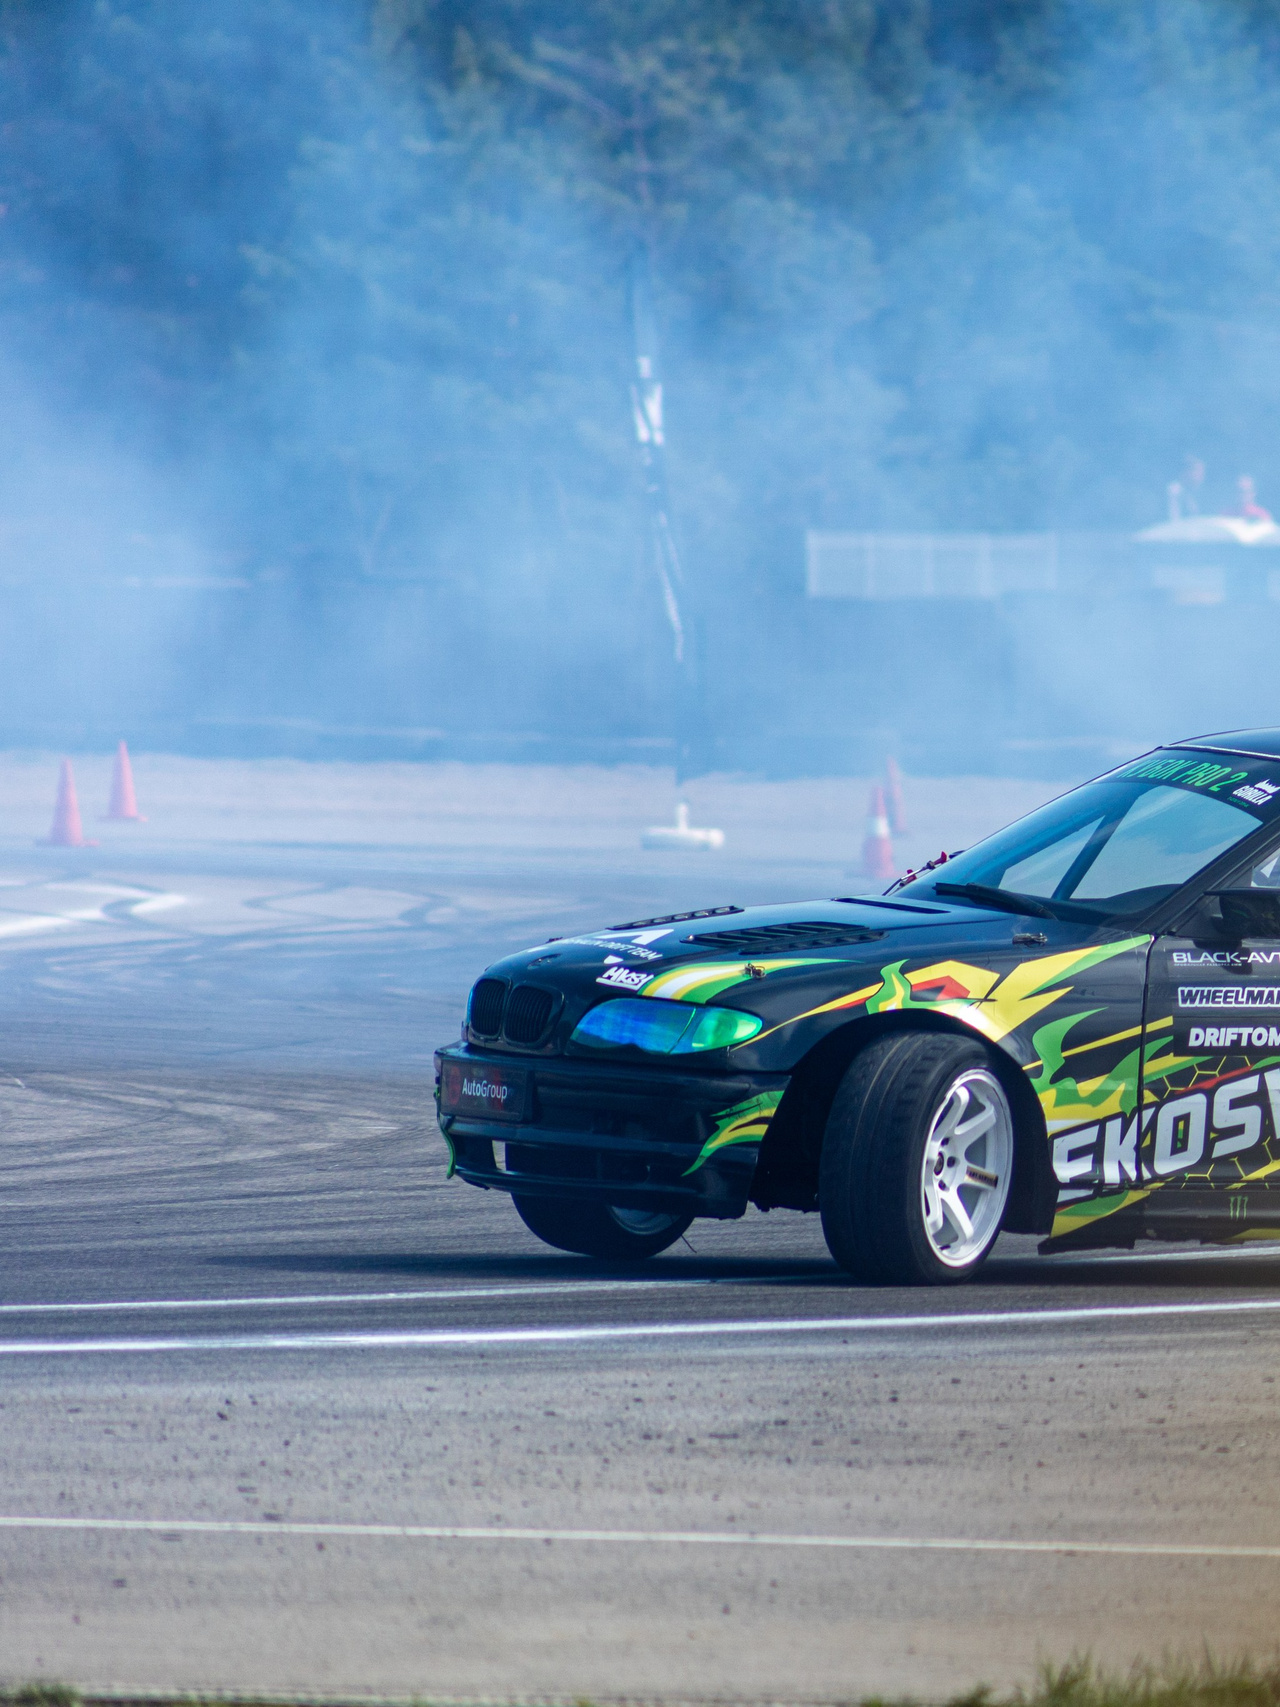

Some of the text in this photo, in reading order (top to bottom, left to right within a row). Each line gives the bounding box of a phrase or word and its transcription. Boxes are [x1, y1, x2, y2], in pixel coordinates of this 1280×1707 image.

[1208, 771, 1248, 792] 2
[1232, 785, 1273, 806] GORILLA
[461, 1078, 508, 1102] AutoGroup
